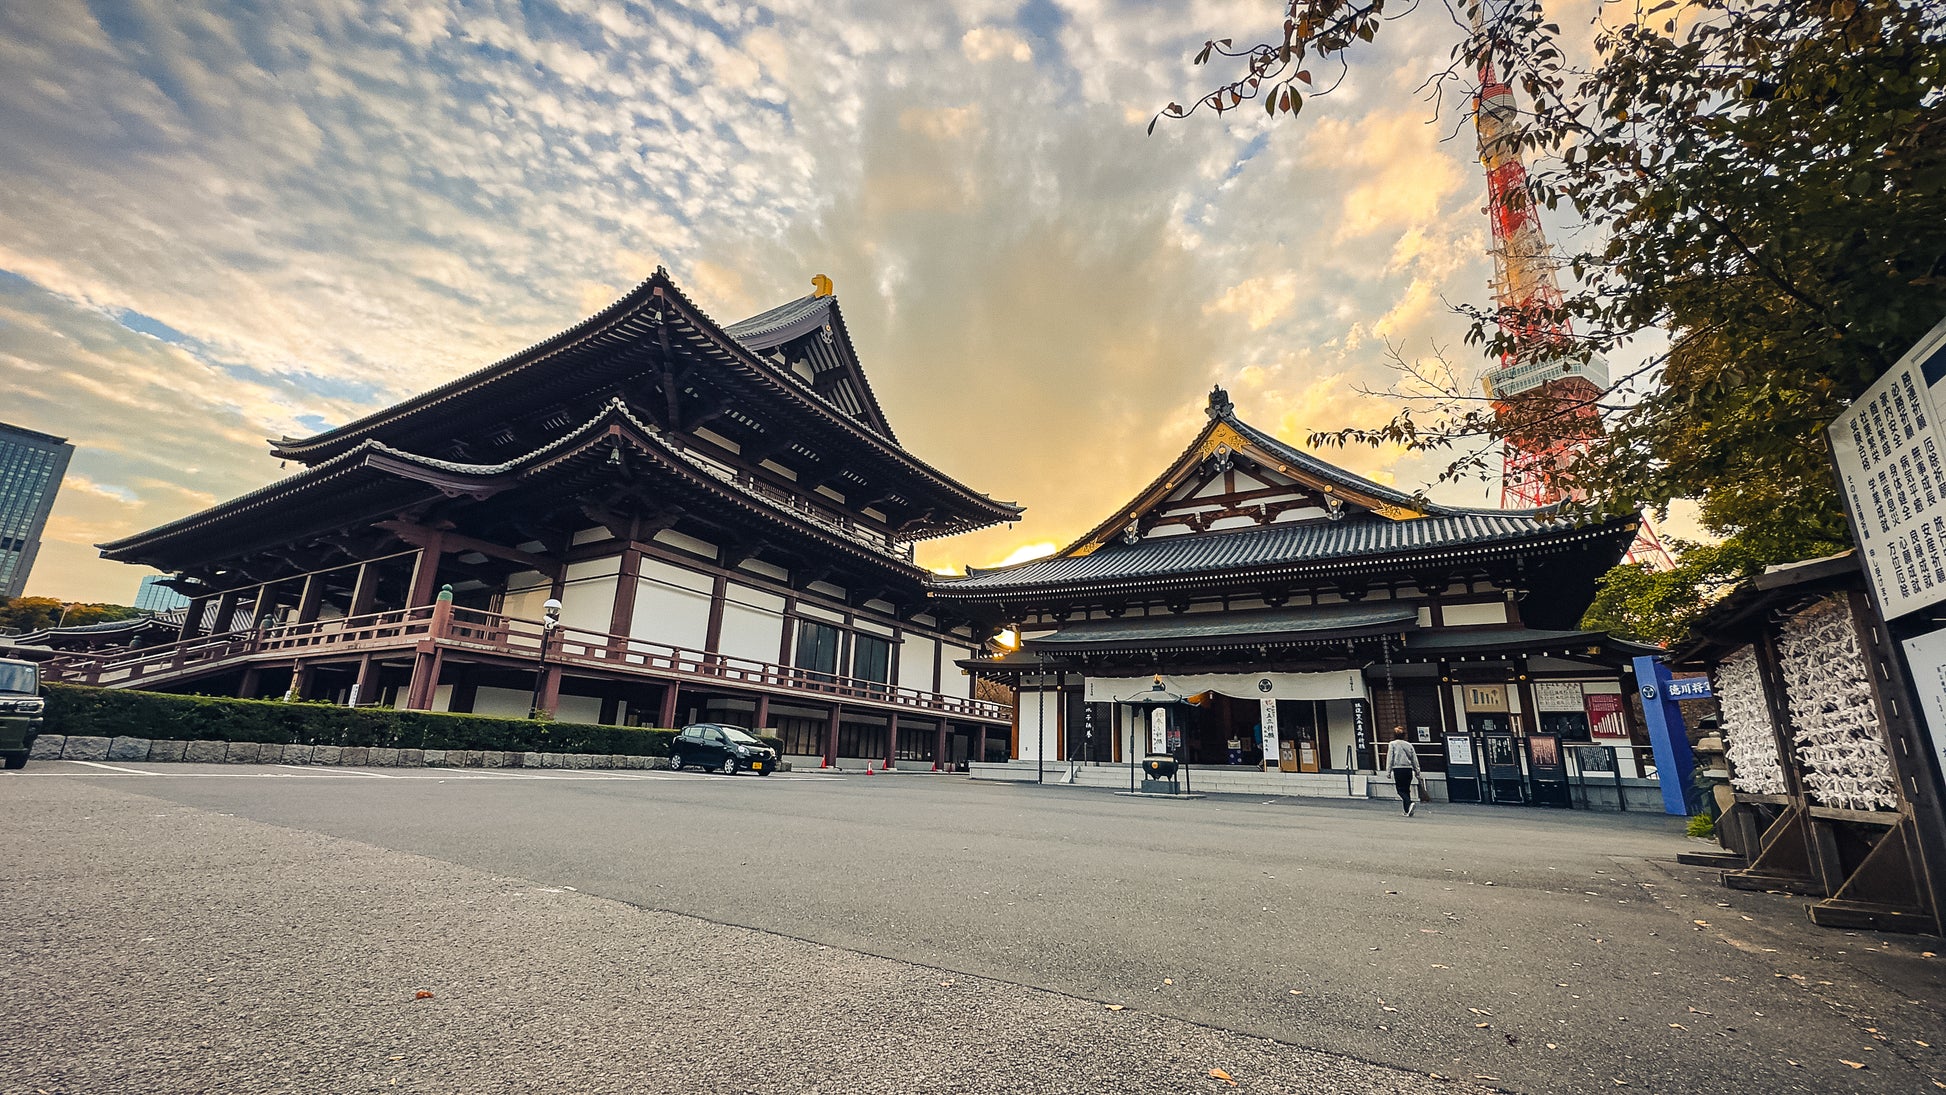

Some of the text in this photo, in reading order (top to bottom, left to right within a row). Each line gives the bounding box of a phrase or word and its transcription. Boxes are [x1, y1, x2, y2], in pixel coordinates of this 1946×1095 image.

[1859, 410, 1881, 464] 社業繁栄
[1869, 400, 1892, 457] 商売繁盛
[1879, 391, 1903, 449] 家内安全
[1891, 381, 1915, 440] 必勝祈願
[1868, 477, 1890, 533] 学業成就
[1878, 471, 1901, 527] 無病息災
[1889, 463, 1912, 521] 身体健全
[1900, 454, 1924, 514] 病気平癒
[1911, 446, 1937, 507] 無事成長
[1909, 529, 1934, 589] 良縁成就
[1921, 522, 1946, 584] 安産祈願
[1933, 515, 1946, 556] 旅行
[1887, 542, 1910, 600] 方位厄除
[1898, 536, 1922, 594] 心願成就
